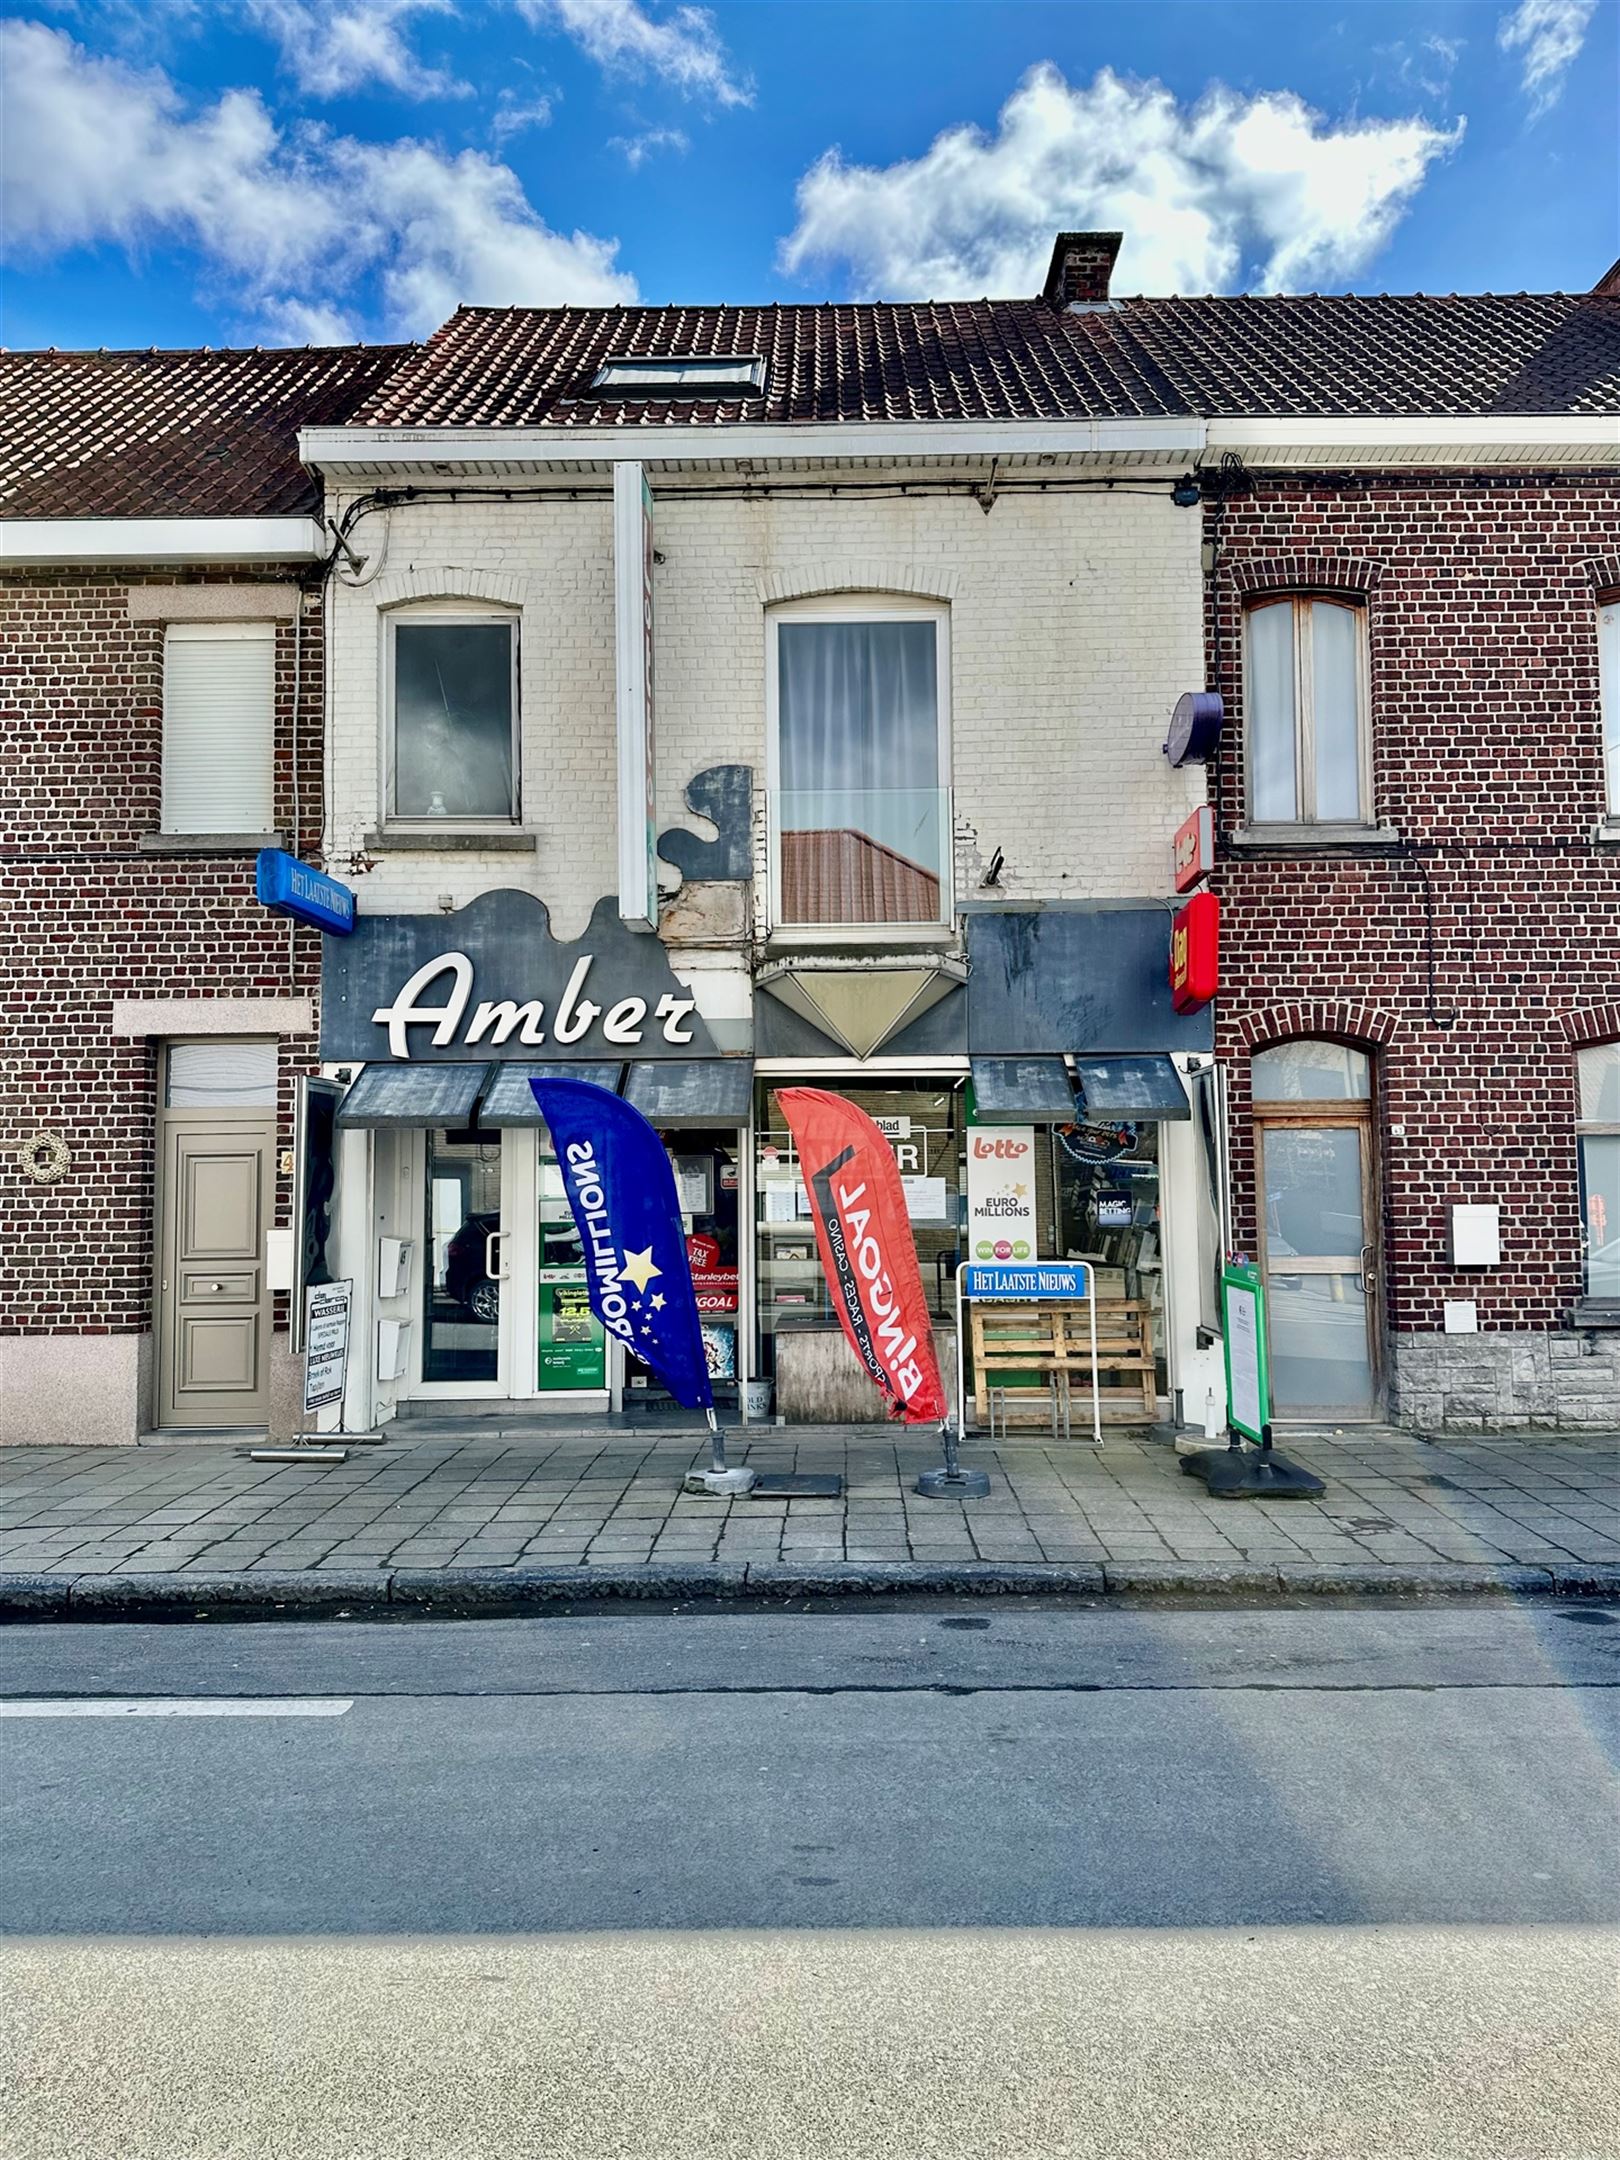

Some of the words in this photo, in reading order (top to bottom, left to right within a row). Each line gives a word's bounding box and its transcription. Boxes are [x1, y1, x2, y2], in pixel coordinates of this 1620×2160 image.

[372, 951, 695, 1059] Amber
[986, 1198, 1018, 1207] EURO
[1099, 1200, 1127, 1208] MAGIC
[974, 1207, 1030, 1217] MILLIONS
[1099, 1207, 1132, 1216] BETTING
[693, 1247, 709, 1258] TAX
[688, 1256, 708, 1268] FREE
[973, 1271, 993, 1290] HET
[995, 1271, 1037, 1290] LAATSTE
[1038, 1271, 1077, 1291] NIEUWS
